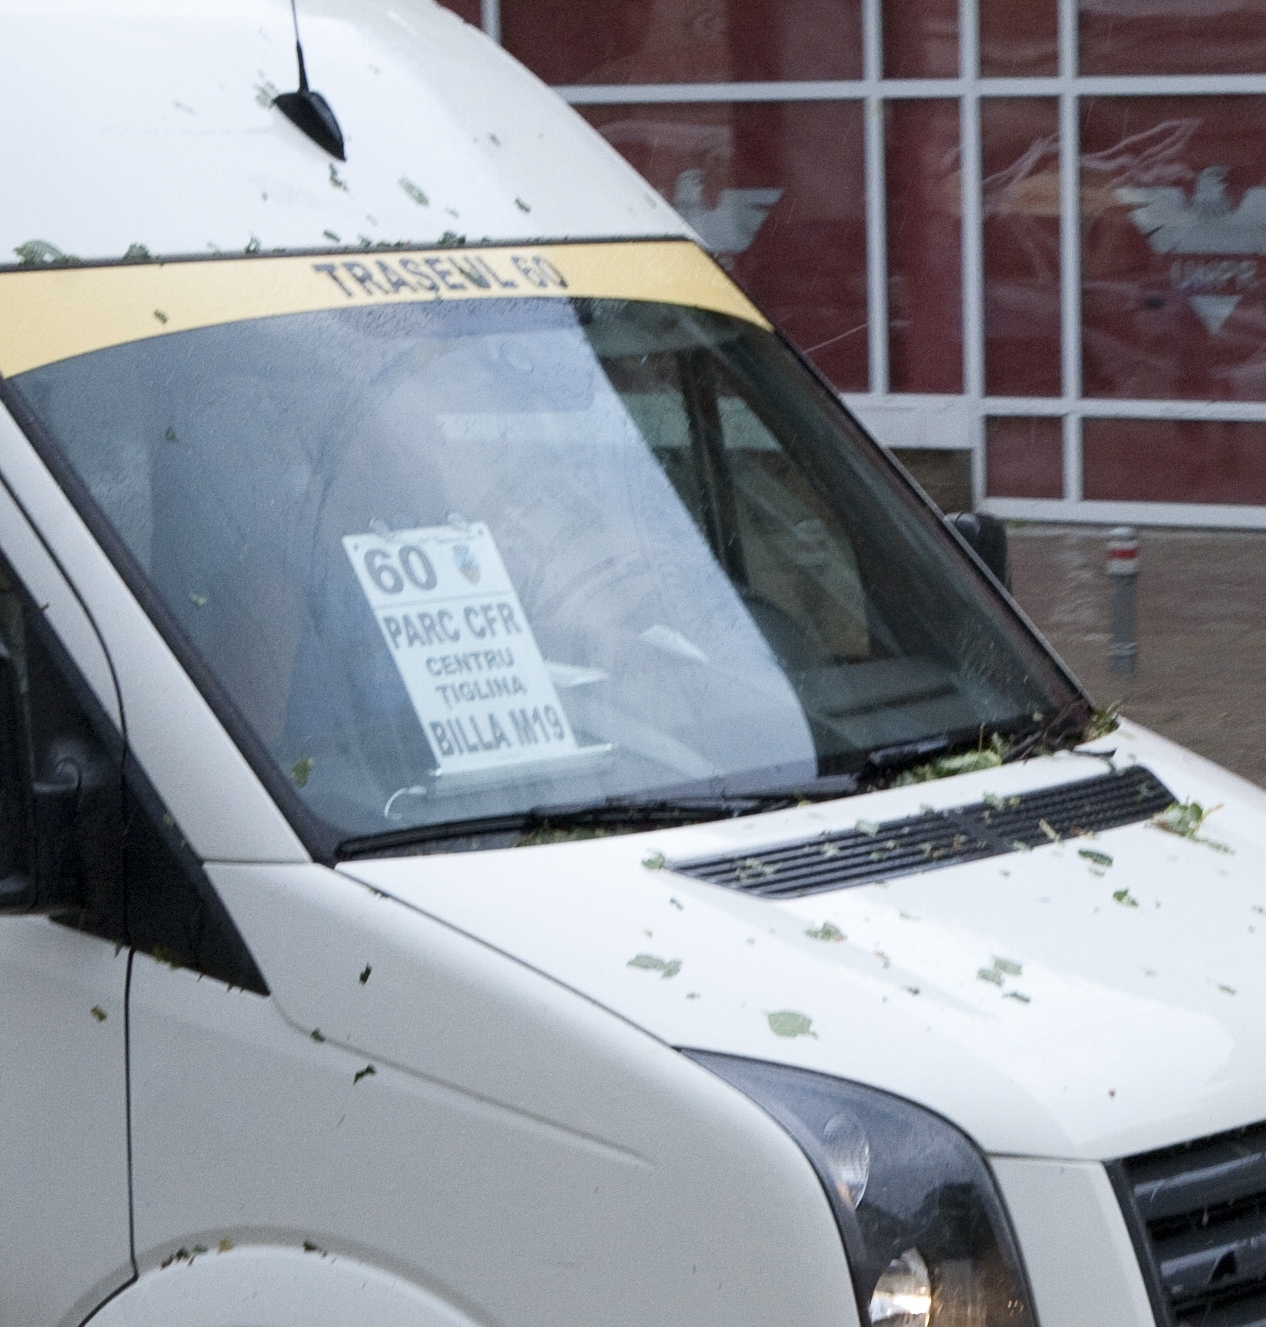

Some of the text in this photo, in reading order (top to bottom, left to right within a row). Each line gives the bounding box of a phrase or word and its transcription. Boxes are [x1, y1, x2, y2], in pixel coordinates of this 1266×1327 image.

[313, 254, 569, 297] TRASEUL 60
[364, 546, 437, 594] 60
[383, 603, 521, 649] PARC CFR
[426, 648, 515, 676] CENTRU
[429, 705, 565, 757] BILLA M19
